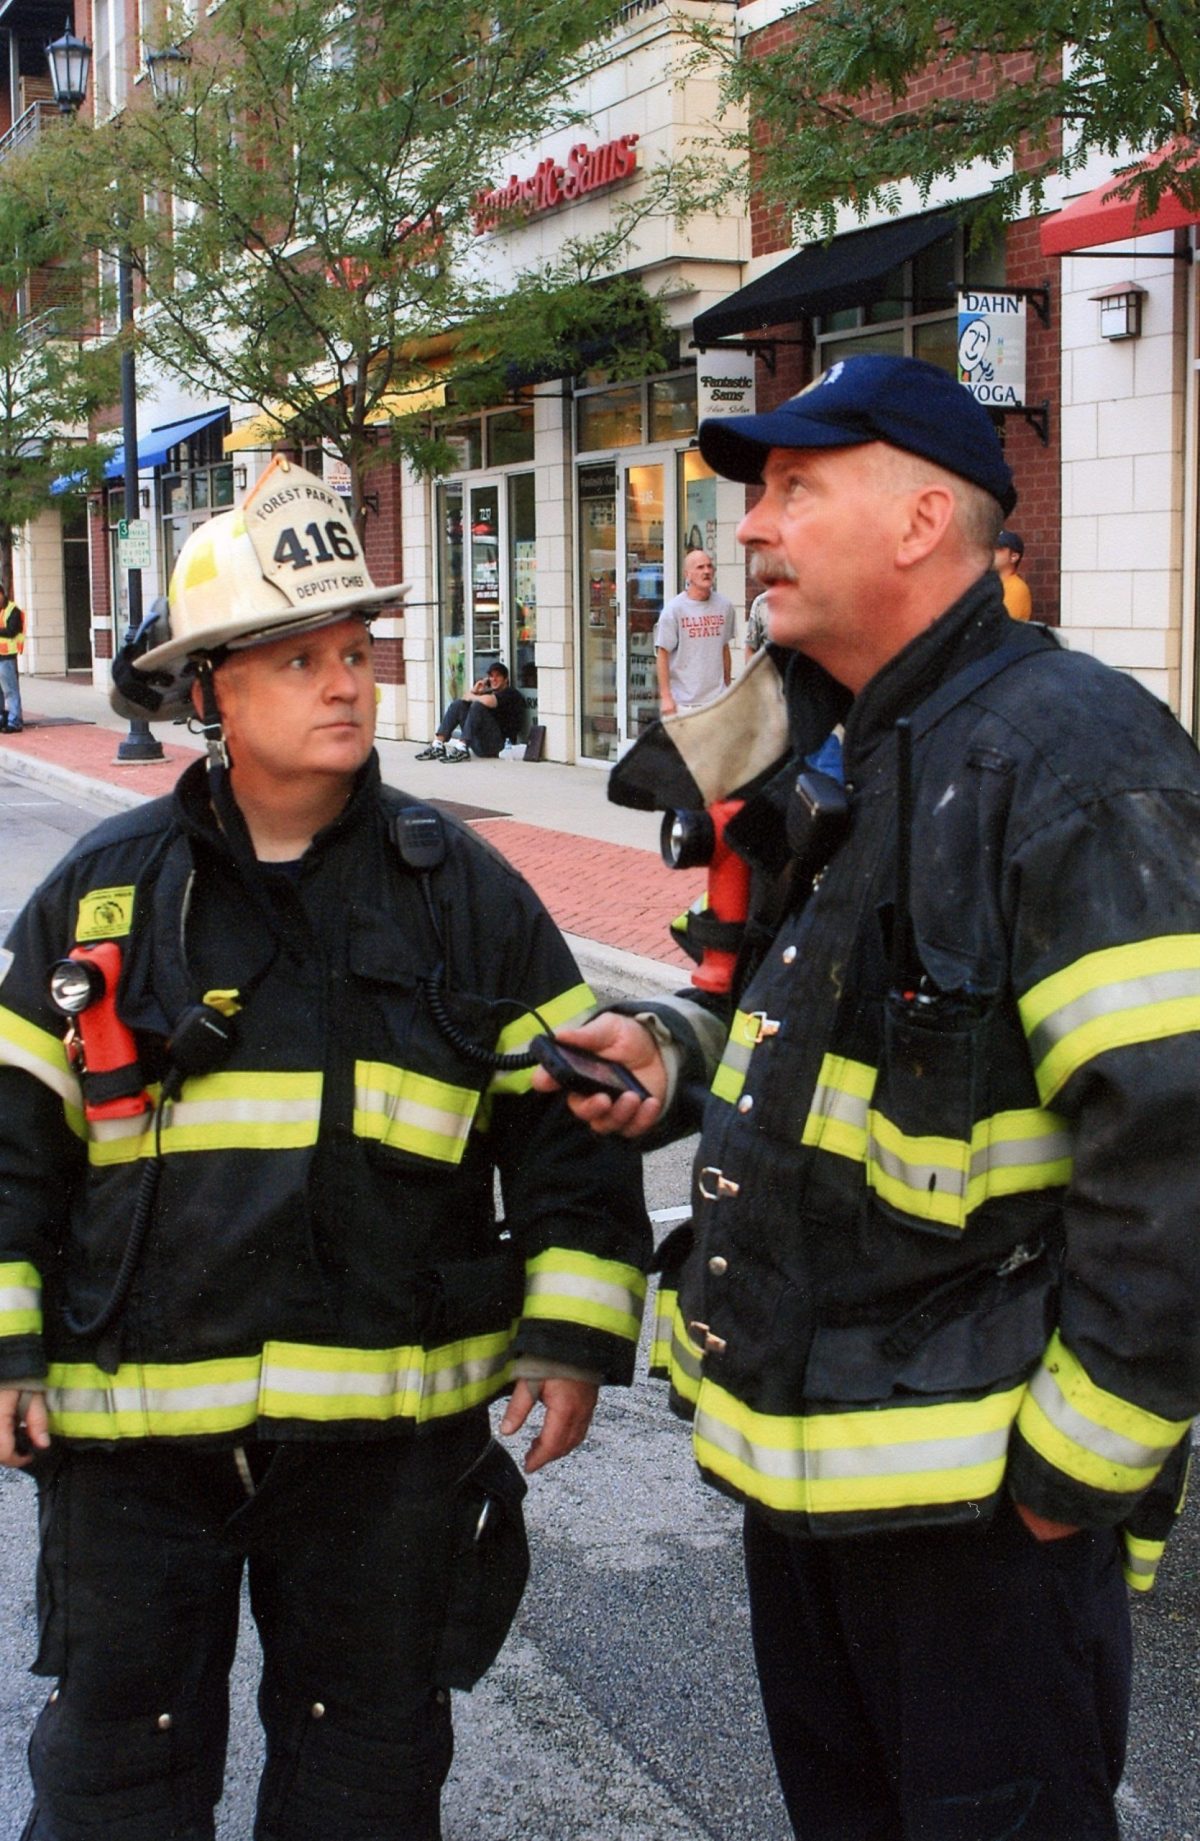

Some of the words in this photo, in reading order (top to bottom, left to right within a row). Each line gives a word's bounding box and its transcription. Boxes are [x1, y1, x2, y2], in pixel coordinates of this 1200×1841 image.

[563, 134, 640, 199] Sams
[967, 294, 1019, 313] DAHN
[700, 375, 752, 388] Fantastic
[711, 388, 745, 401] Sams
[256, 488, 301, 521] FOREST
[306, 488, 334, 508] PARK
[120, 523, 128, 535] 3
[273, 521, 358, 571] 416
[296, 578, 339, 599] DEPUTY
[341, 575, 363, 588] CHIEF
[681, 615, 724, 628] ILLINOIS
[688, 626, 721, 638] STATE
